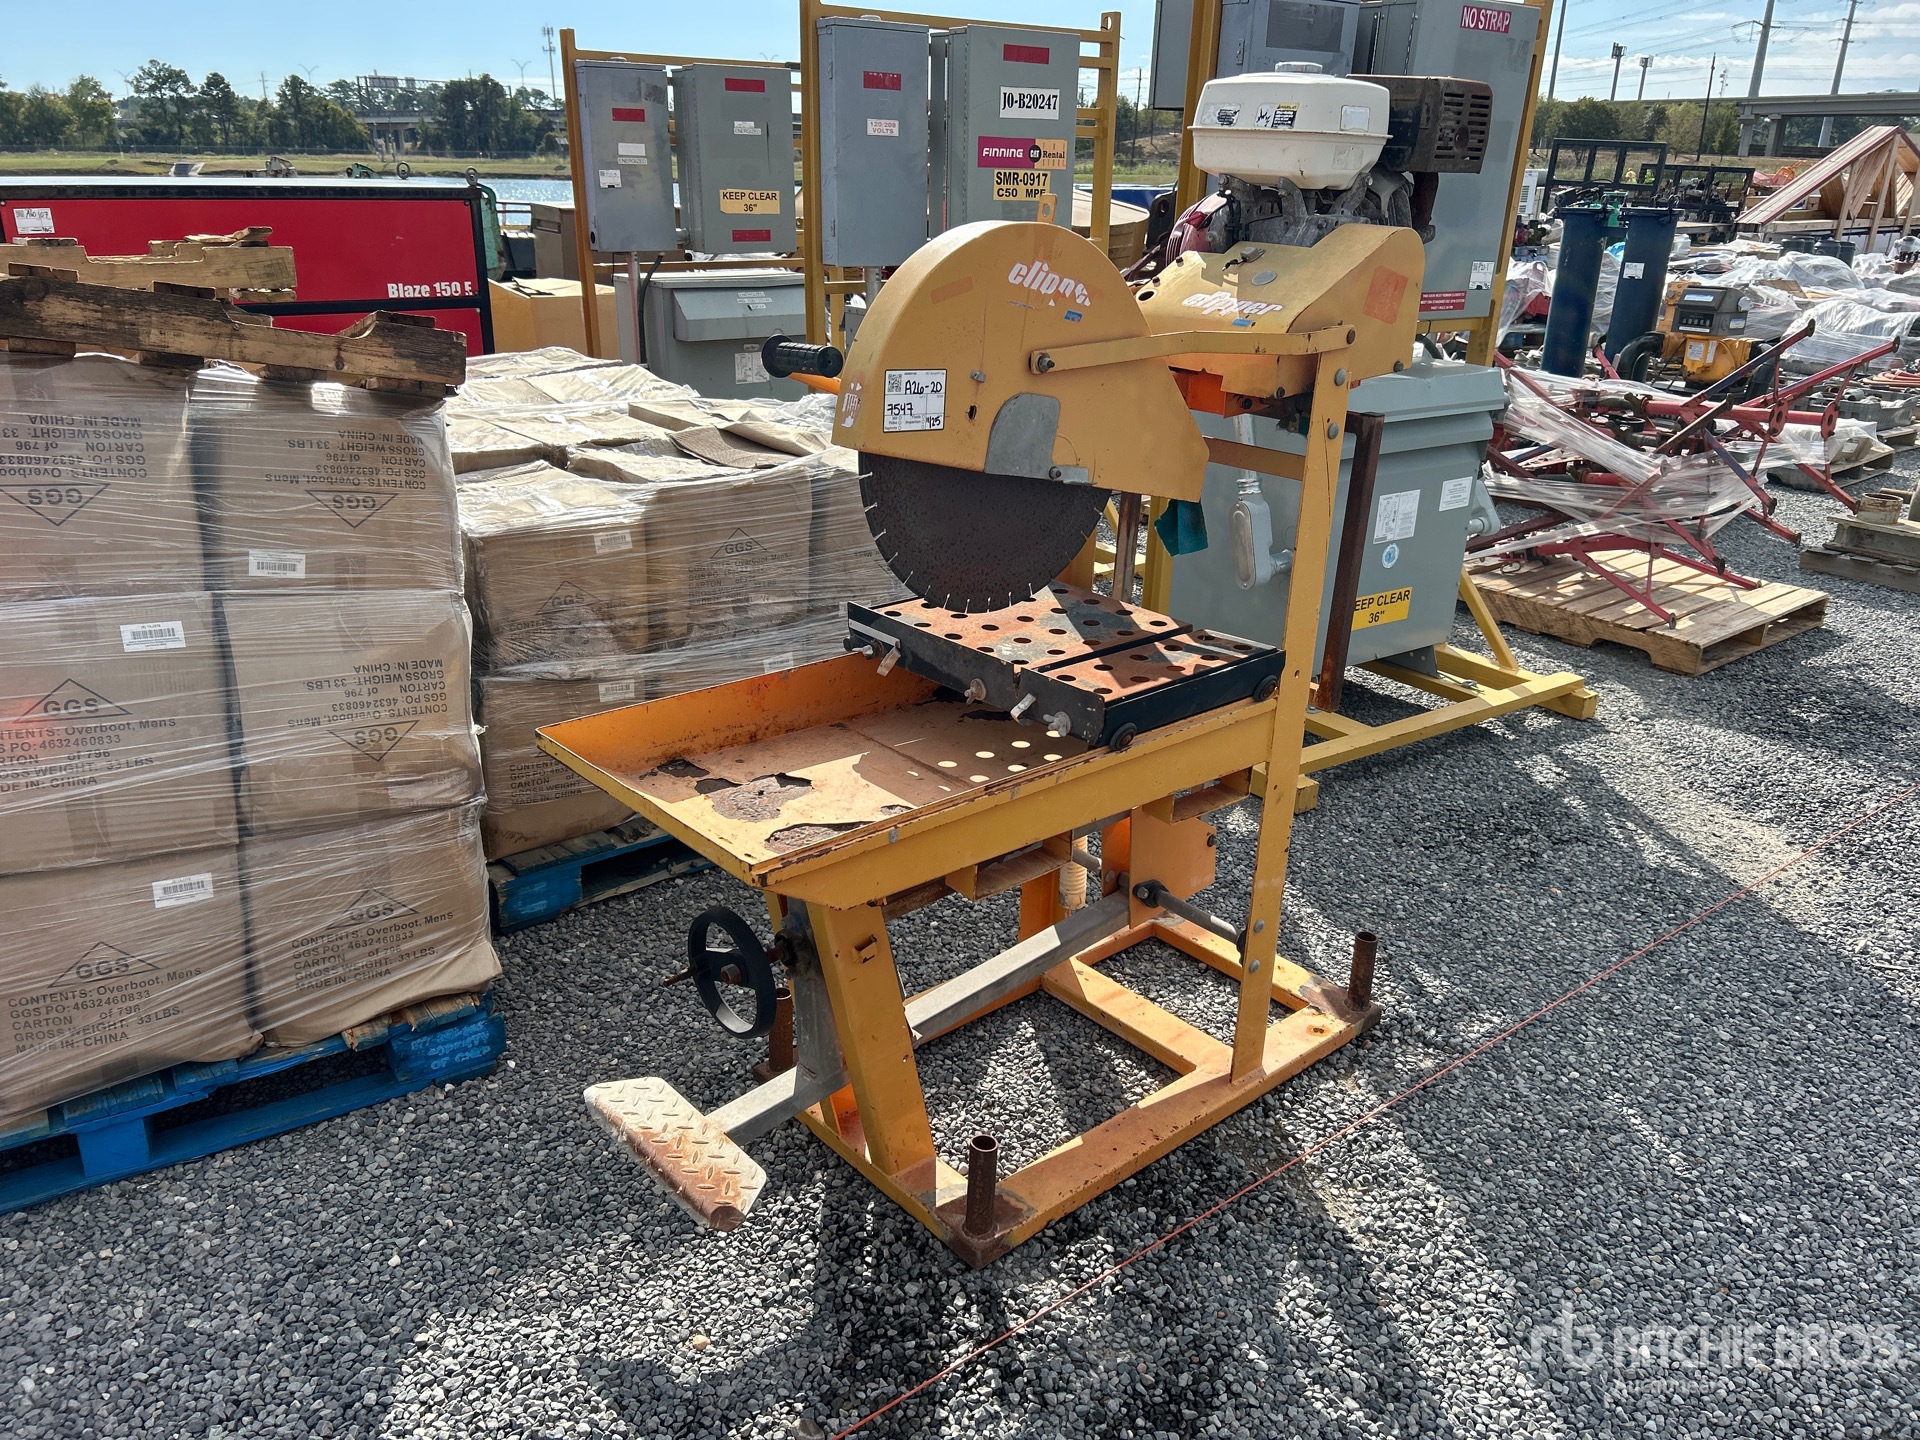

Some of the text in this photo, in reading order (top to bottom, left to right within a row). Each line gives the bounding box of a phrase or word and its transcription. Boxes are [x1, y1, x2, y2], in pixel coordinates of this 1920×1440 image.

[1462, 7, 1510, 31] NO STRAP
[982, 148, 1065, 159] FINNING CAT Rental
[996, 172, 1048, 186] SMR-0917
[723, 192, 777, 200] KEEP CLEAR
[997, 188, 1018, 197] C50
[744, 204, 757, 212] 36"
[387, 283, 430, 298] Blaze
[433, 282, 461, 296] 150
[1182, 291, 1283, 316] clipper
[905, 380, 942, 395] A26-20
[887, 402, 913, 416] 7547
[28, 415, 74, 425] CHINA
[102, 416, 141, 427] MADE
[2, 428, 143, 439] GROSS WEIGHT: 33
[338, 430, 375, 441] CHINA
[16, 442, 144, 452] CARTON of 796
[317, 440, 330, 449] 33
[389, 445, 424, 456] GROSS
[115, 456, 146, 465] GGS
[326, 453, 346, 462] 796
[382, 457, 425, 467] CARTON
[0, 467, 62, 478] Overboo
[404, 469, 425, 478] GGS
[364, 479, 426, 489] CONTENTS:
[28, 488, 82, 505] GGS
[332, 495, 376, 509] GGS
[725, 541, 753, 554] GGS
[552, 592, 585, 607] GGS
[1354, 589, 1410, 611] EEP CLEAR
[1368, 610, 1385, 624] 36"
[353, 659, 443, 674] MADE IN: CHINA
[303, 670, 444, 691] GROSS WEIGHT: 33 LBS.
[344, 681, 446, 698] CARTON of 796
[43, 698, 100, 716] GGS
[332, 692, 447, 712] GGS PO: 4632460833
[384, 703, 448, 718] CONTENTS:
[65, 721, 136, 736] Overboot,
[139, 718, 177, 730] Mens
[10, 742, 37, 752] PO:
[39, 734, 121, 749] 4632460833
[354, 727, 398, 745] GGS
[0, 754, 39, 767] RTON
[0, 782, 21, 792] DE
[50, 776, 98, 789] CHINA
[511, 778, 550, 789] CARTON
[554, 789, 582, 799] CHINA
[350, 903, 394, 921] GGS
[291, 912, 454, 949] CONTENTS: Overboot, Mens
[323, 944, 344, 955] PO:
[347, 930, 414, 950] 4632460833
[76, 957, 130, 980] GGS
[293, 954, 346, 970] CARTON
[294, 968, 337, 982] GROSS
[398, 953, 411, 962] 33
[413, 946, 439, 959] LBS.
[354, 968, 392, 981] CHINA
[8, 967, 202, 1008] CONTENTS: Overboot, Mens
[10, 989, 150, 1019] GGS PO: 4632460833
[12, 1004, 141, 1031] CARTON of 796
[14, 1028, 64, 1042] GROSS
[137, 1015, 152, 1025] 33
[154, 1006, 184, 1022] LBS.
[83, 1031, 129, 1047] CHINA
